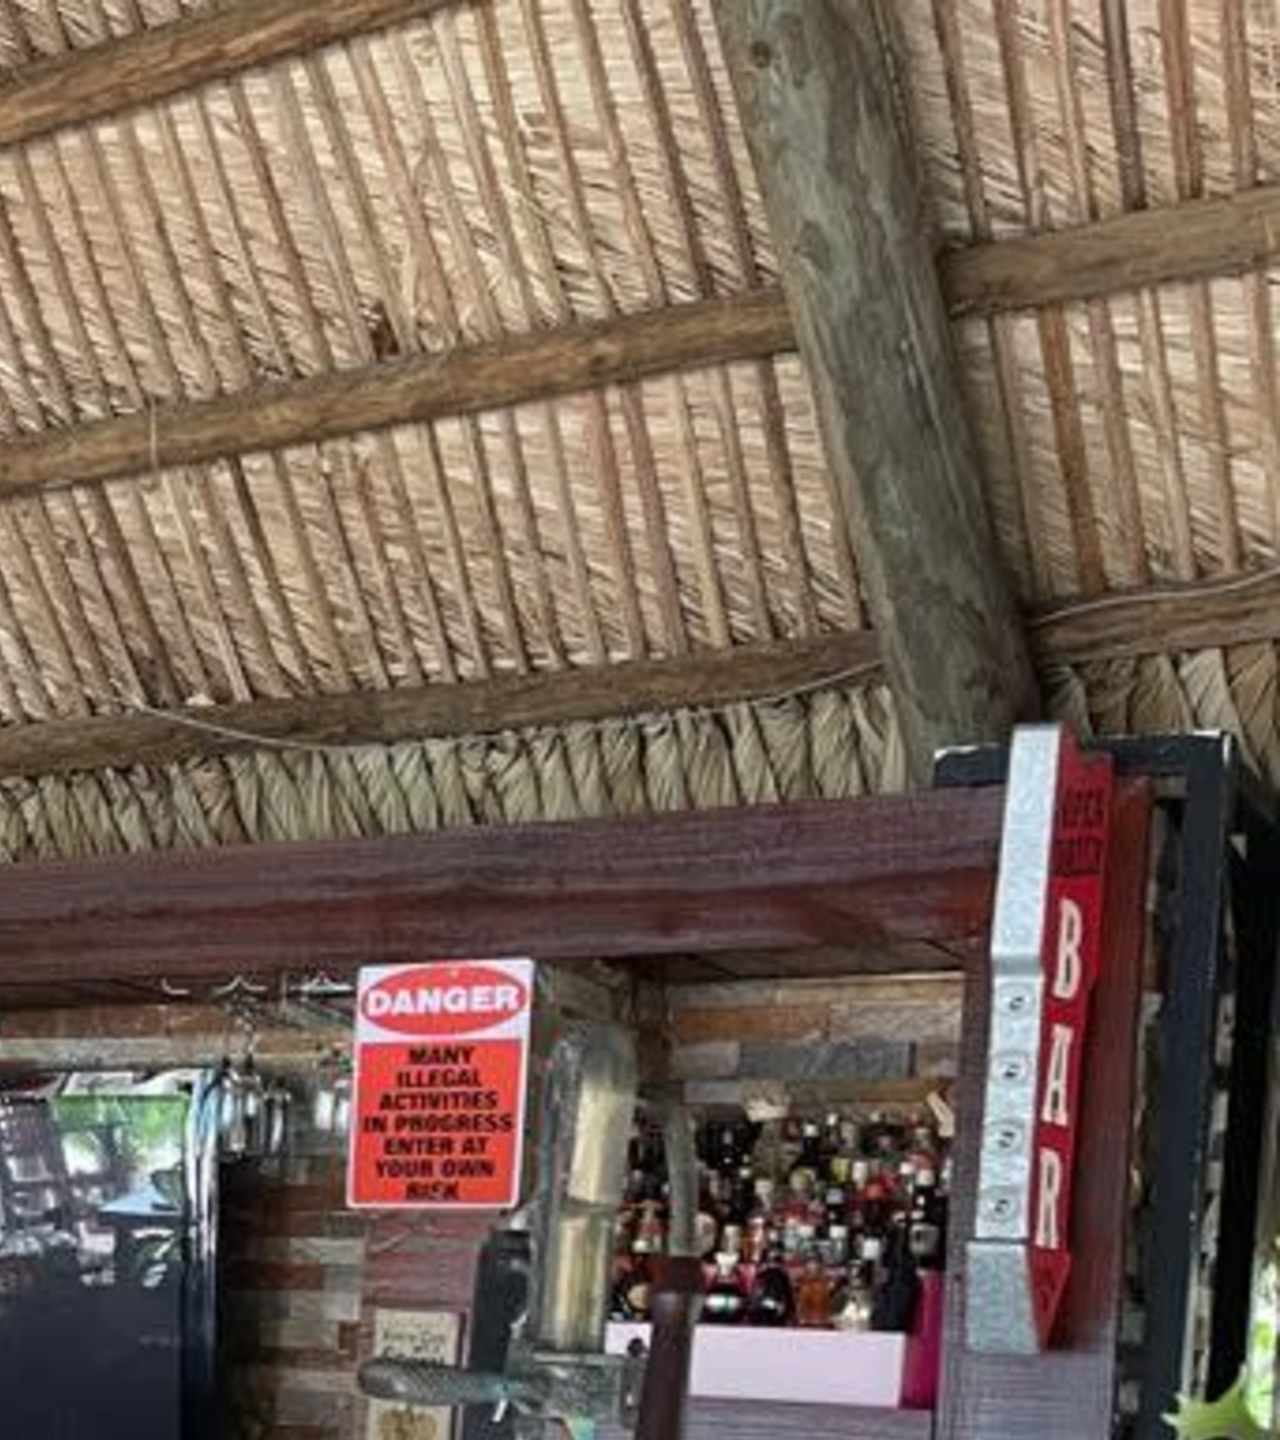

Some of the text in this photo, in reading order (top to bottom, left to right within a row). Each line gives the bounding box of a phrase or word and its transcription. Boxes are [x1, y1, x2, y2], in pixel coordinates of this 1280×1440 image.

[365, 985, 519, 1016] DANGER
[408, 1046, 474, 1065] MANY
[397, 1069, 482, 1088] ILLEGAL
[1035, 897, 1082, 1249] BAR
[379, 1091, 498, 1111] ACTIVITIES
[363, 1113, 513, 1134] IN PROGRESS
[384, 1136, 490, 1156] ENTER AT
[376, 1159, 495, 1178] YOUR OWN
[406, 1182, 460, 1201] RISK
